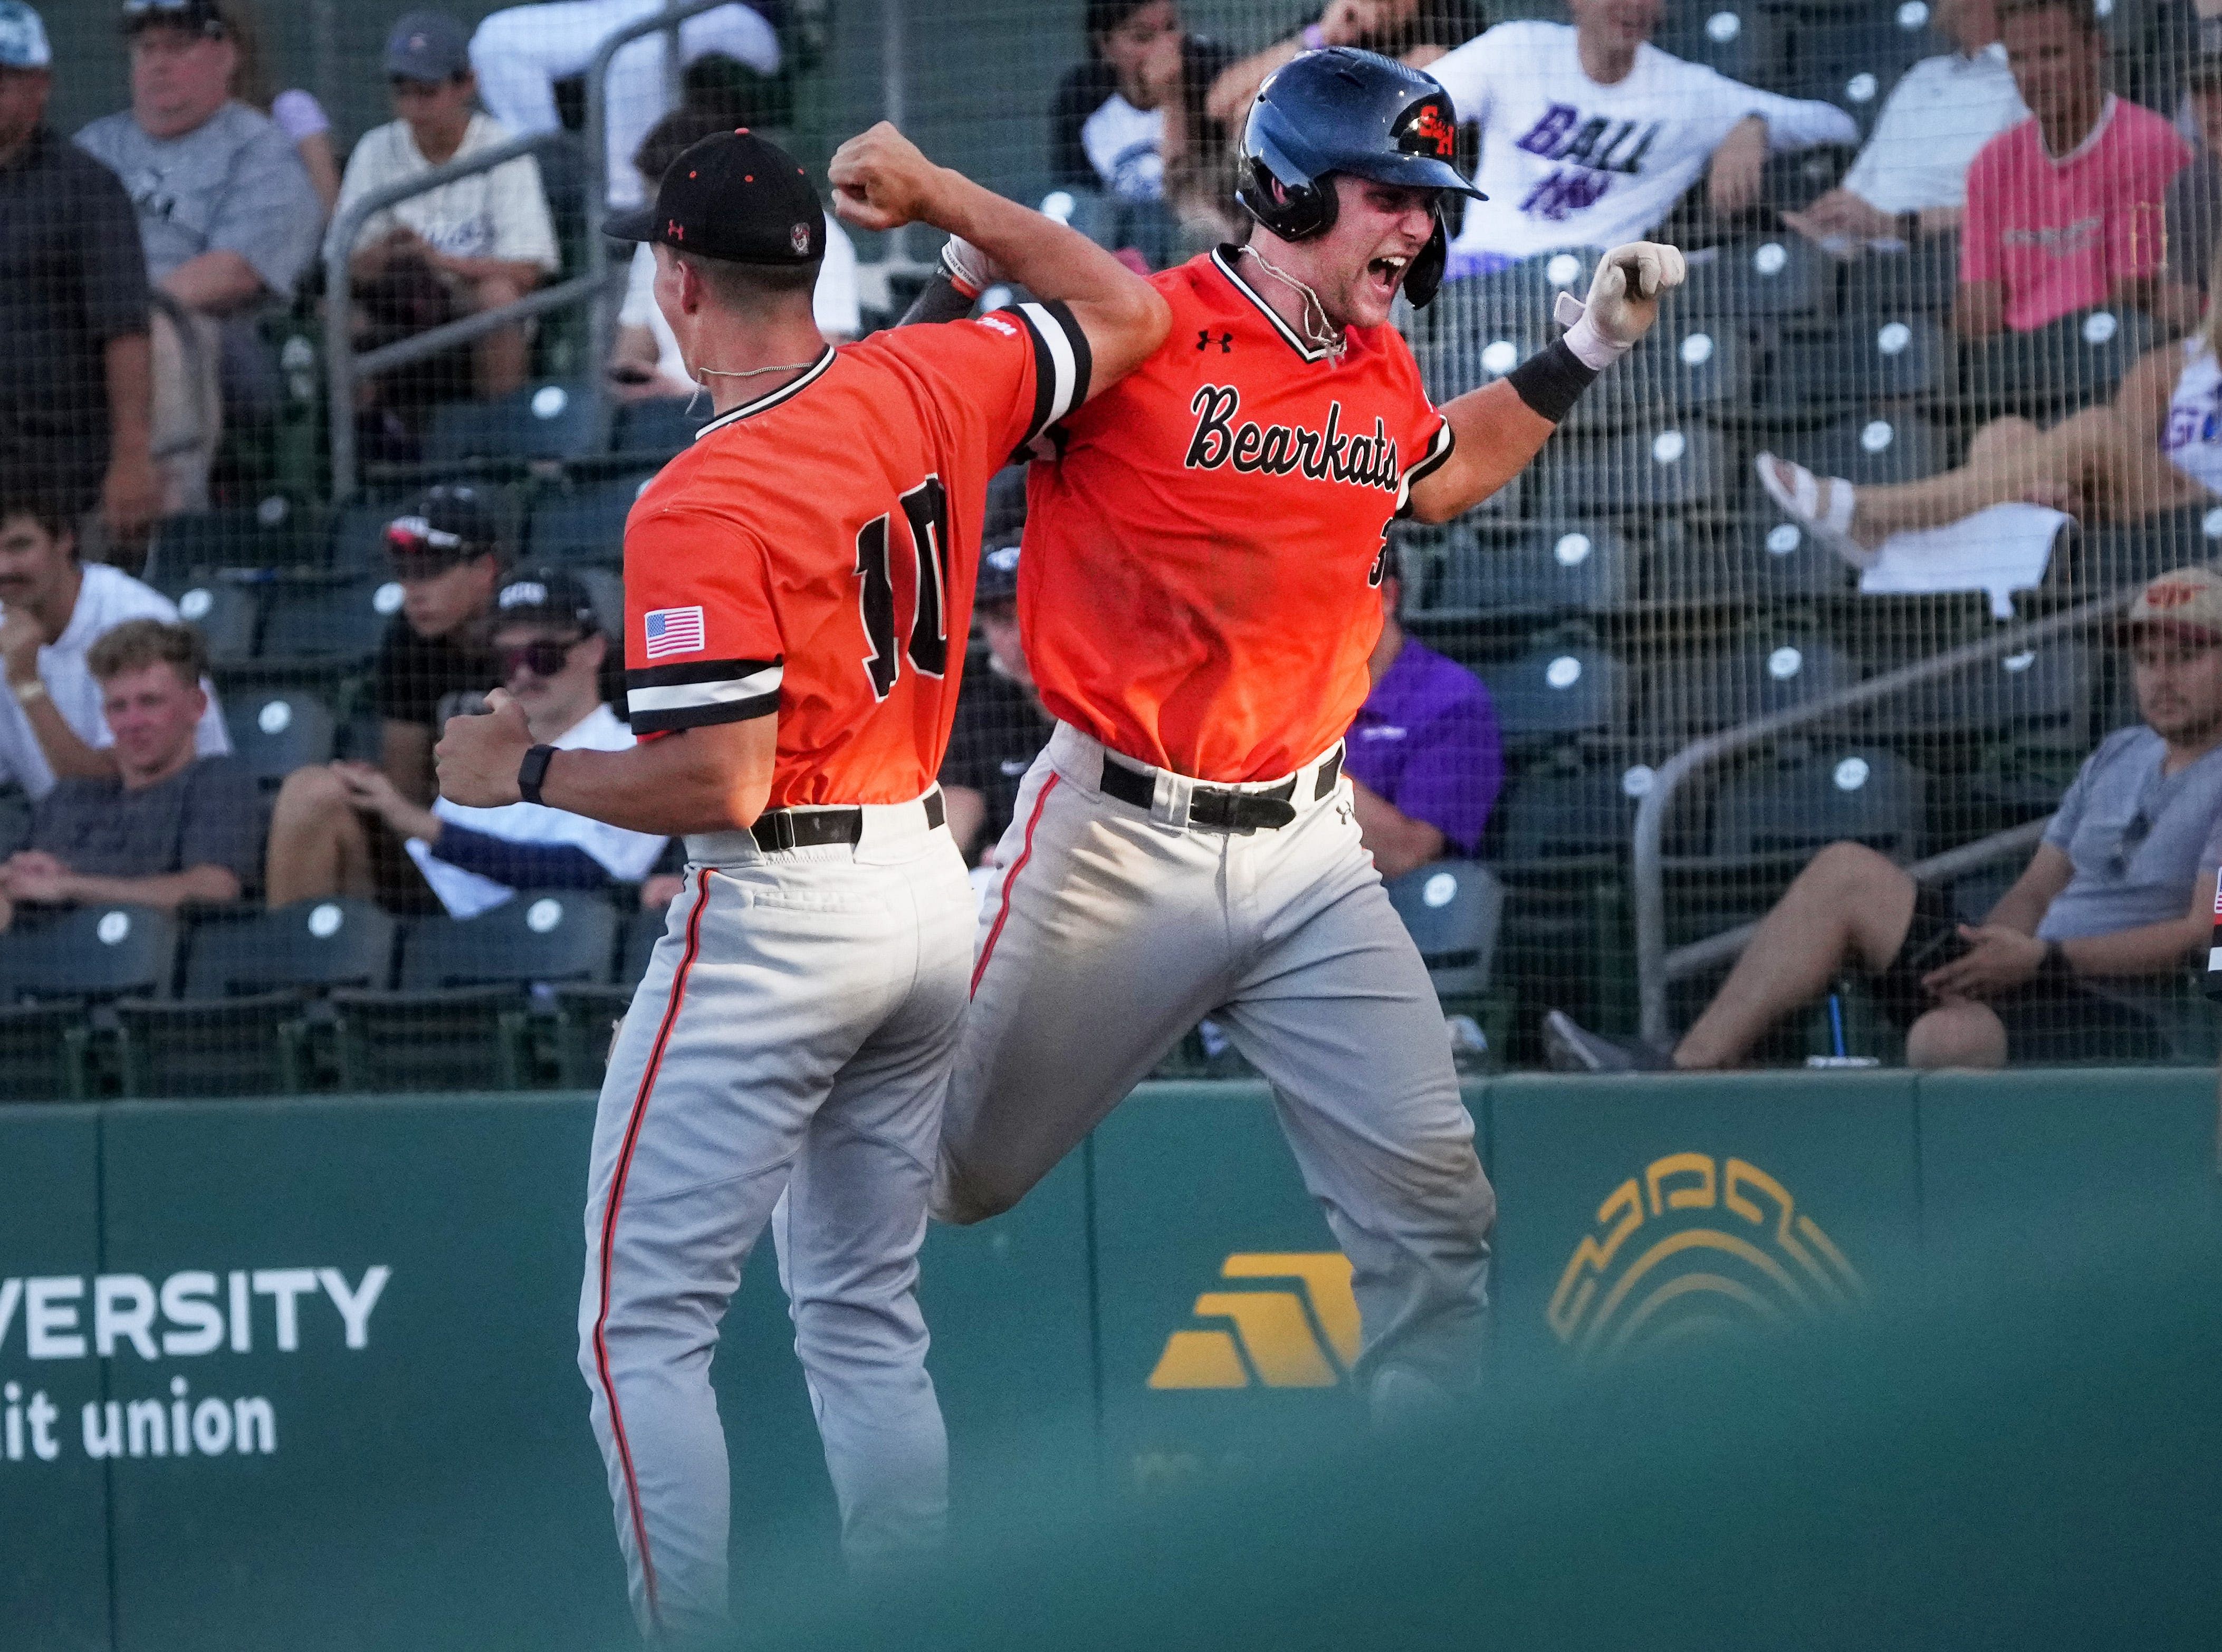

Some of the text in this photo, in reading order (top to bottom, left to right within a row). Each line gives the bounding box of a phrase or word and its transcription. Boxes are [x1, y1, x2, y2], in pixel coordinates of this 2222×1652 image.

[1513, 102, 1661, 174] BALL
[1185, 383, 1401, 494] Bearkats
[852, 472, 947, 703] 10
[0, 1375, 278, 1461] it union
